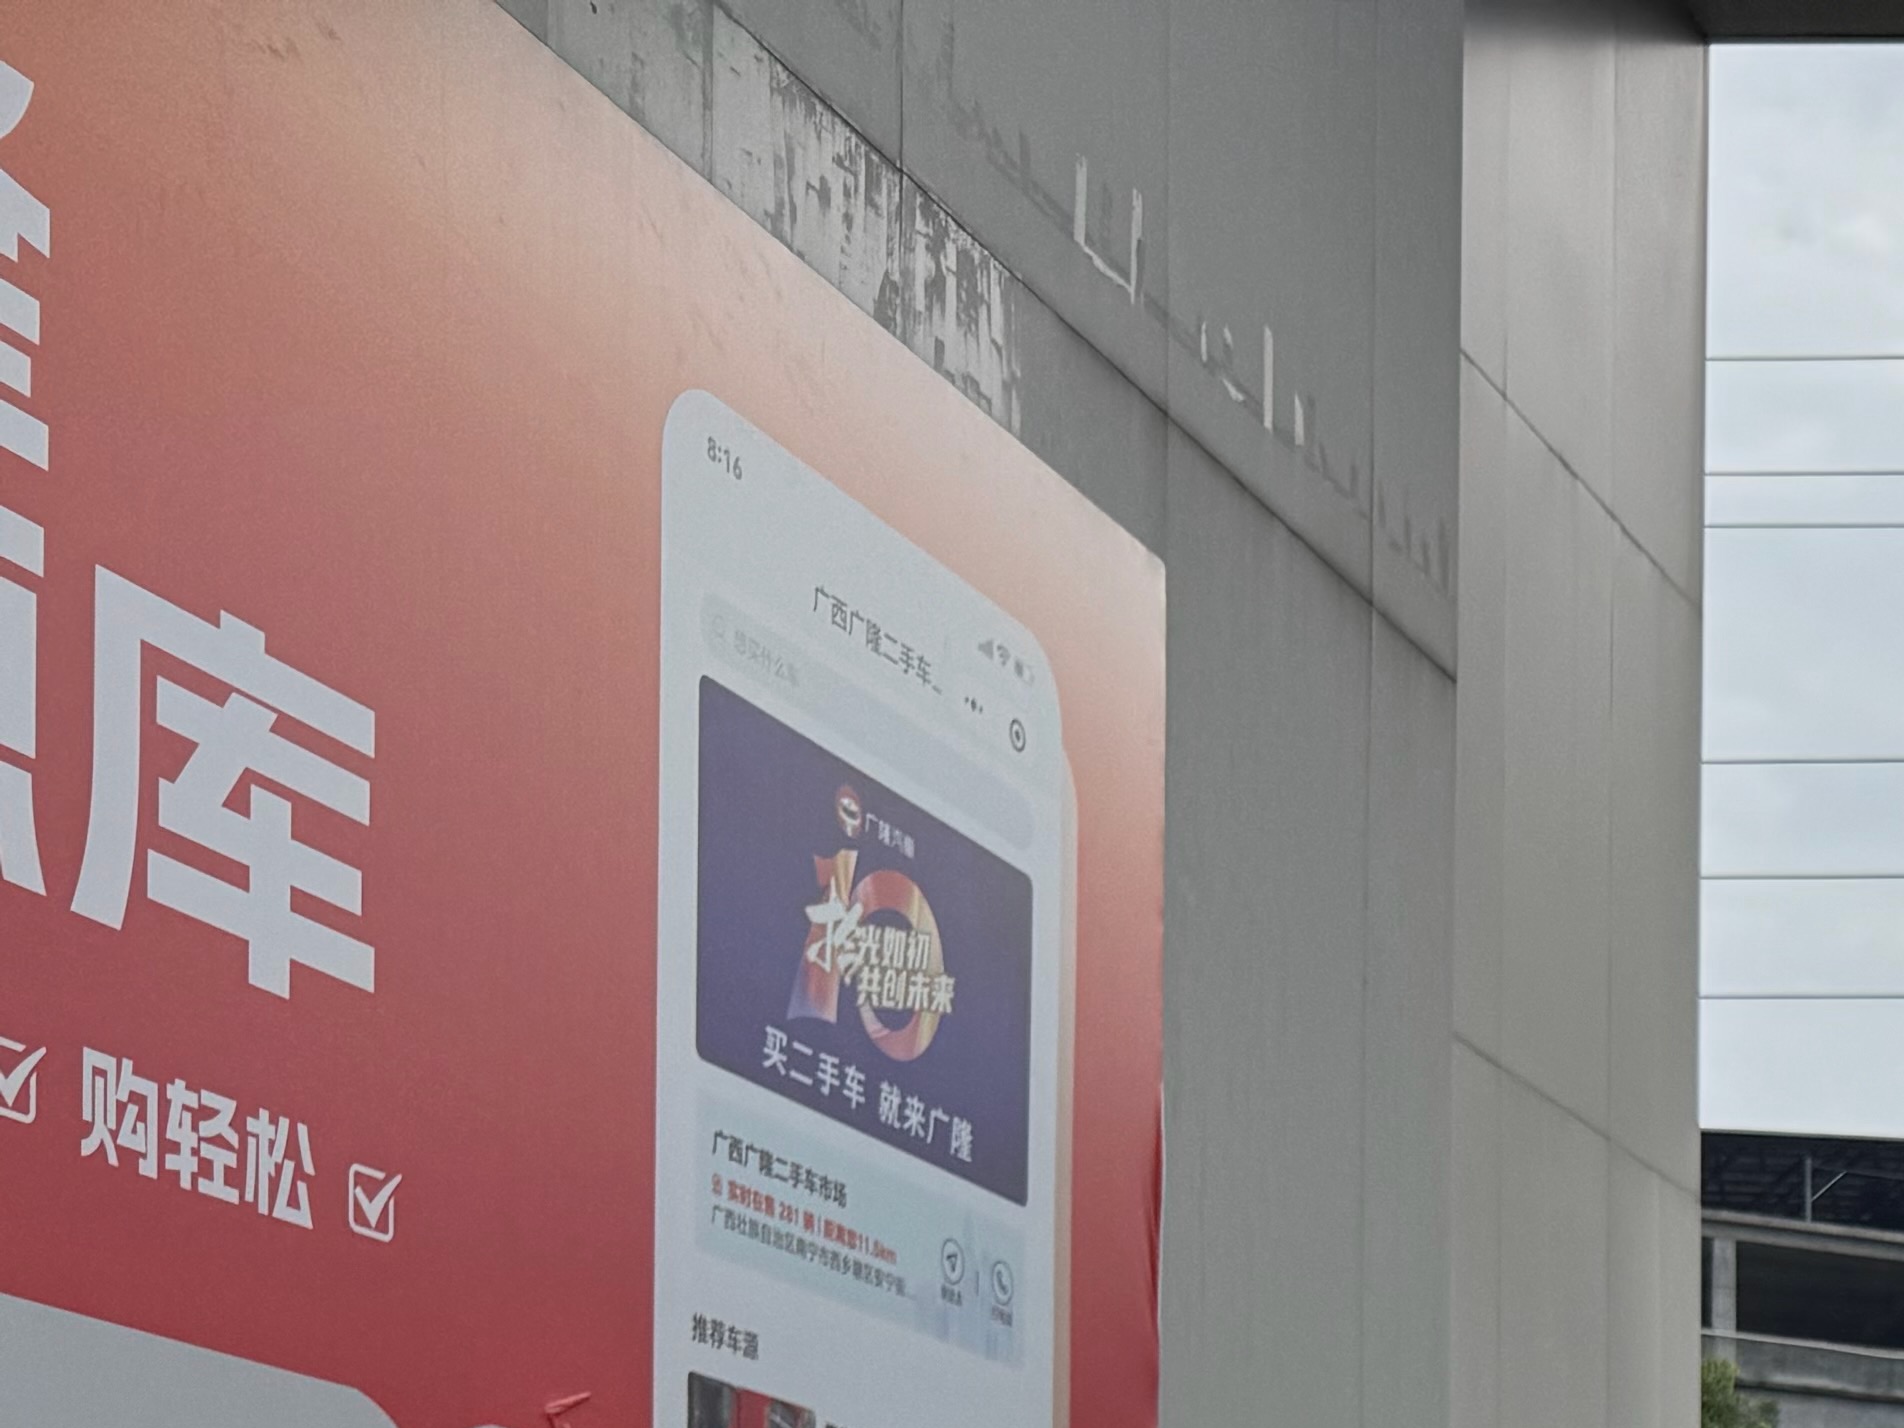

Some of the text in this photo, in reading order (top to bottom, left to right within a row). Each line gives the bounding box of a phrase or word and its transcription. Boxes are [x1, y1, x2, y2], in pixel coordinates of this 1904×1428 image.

[706, 435, 743, 481] 8:16
[856, 965, 956, 1015] 共创未来
[762, 1024, 975, 1164] 买二手车 就来广隆
[80, 1045, 316, 1232] 购轻松
[712, 1130, 848, 1209] 广西广隆二手车市场
[691, 1312, 760, 1361] 推荐车源
